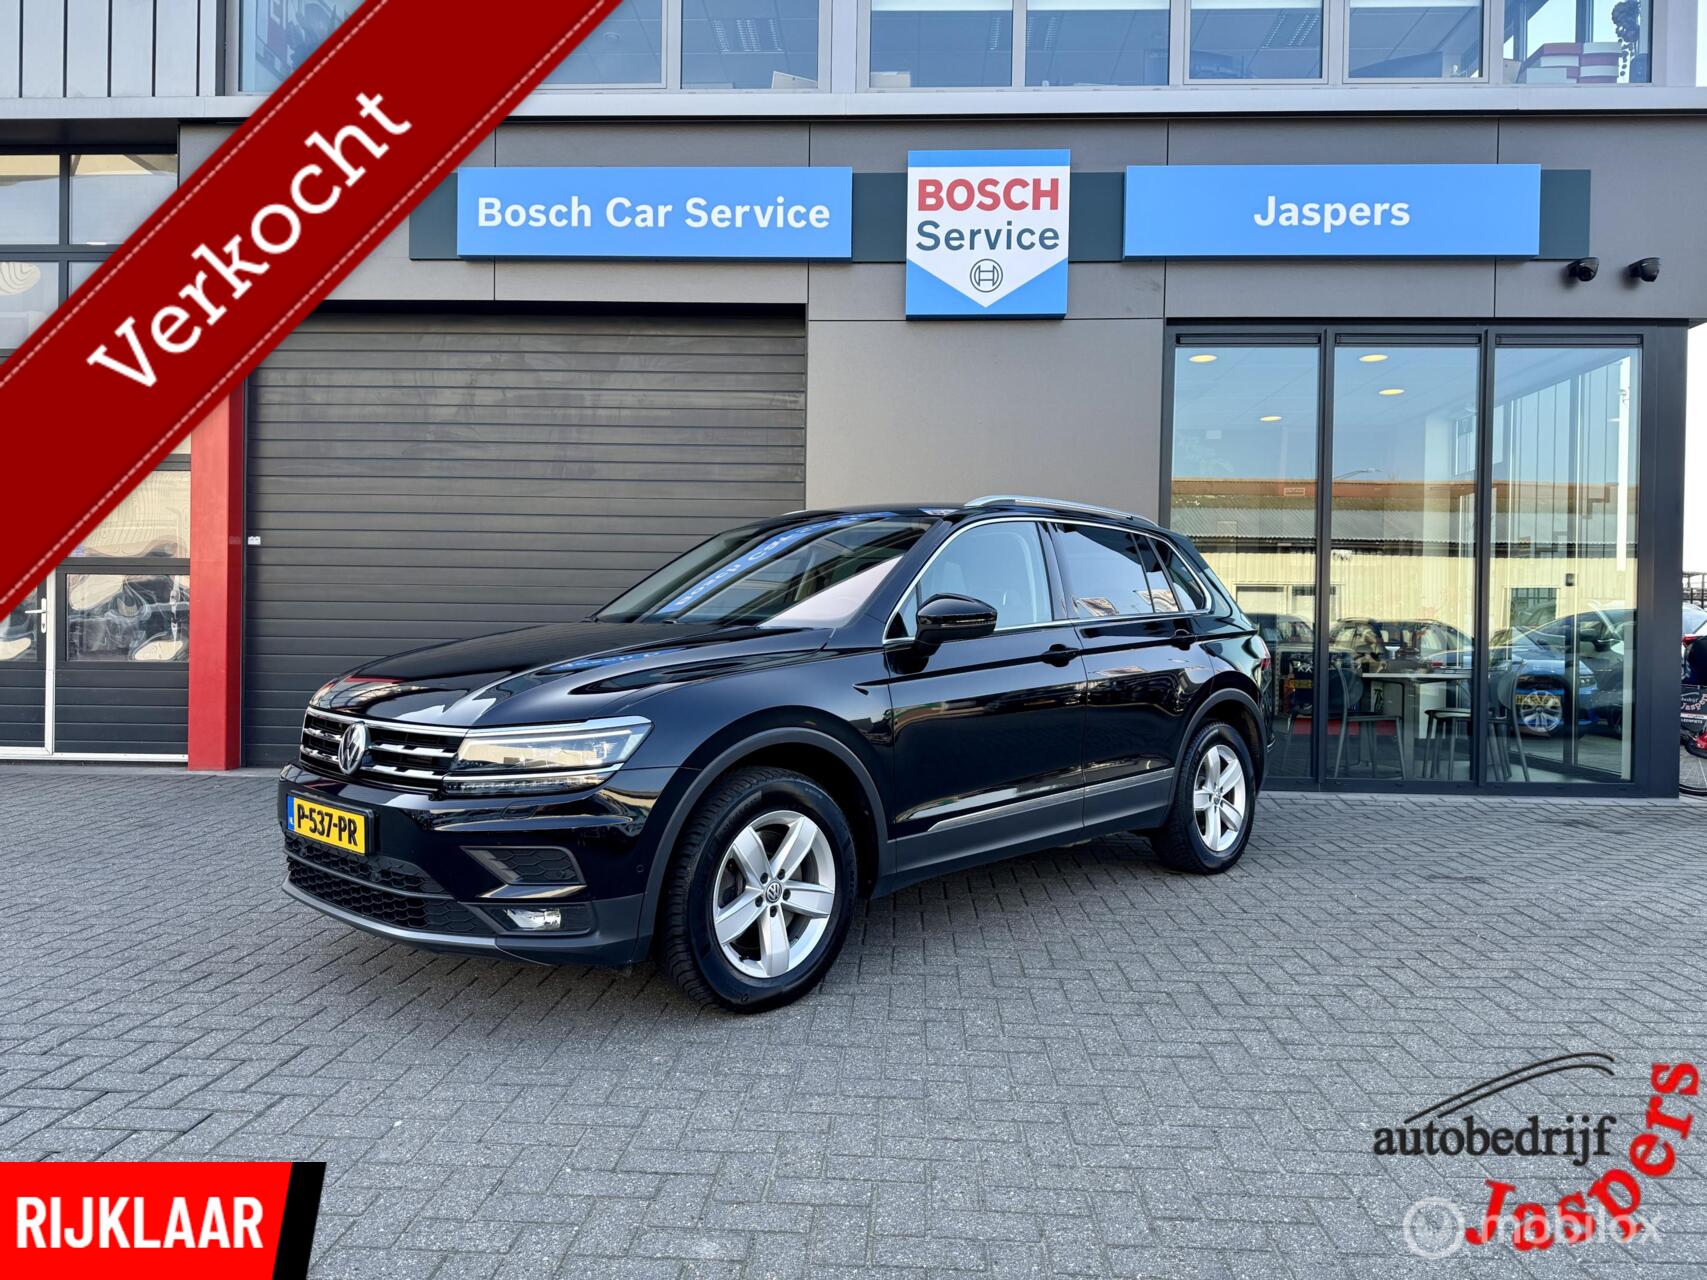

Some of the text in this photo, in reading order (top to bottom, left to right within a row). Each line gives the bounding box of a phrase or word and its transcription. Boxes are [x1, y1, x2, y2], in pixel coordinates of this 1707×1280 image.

[477, 195, 831, 229] Bosch Car Service
[917, 177, 1060, 213] BOSCH
[1253, 195, 1411, 233] Jaspers
[915, 219, 1061, 251] Service
[297, 804, 358, 847] P-537-PR
